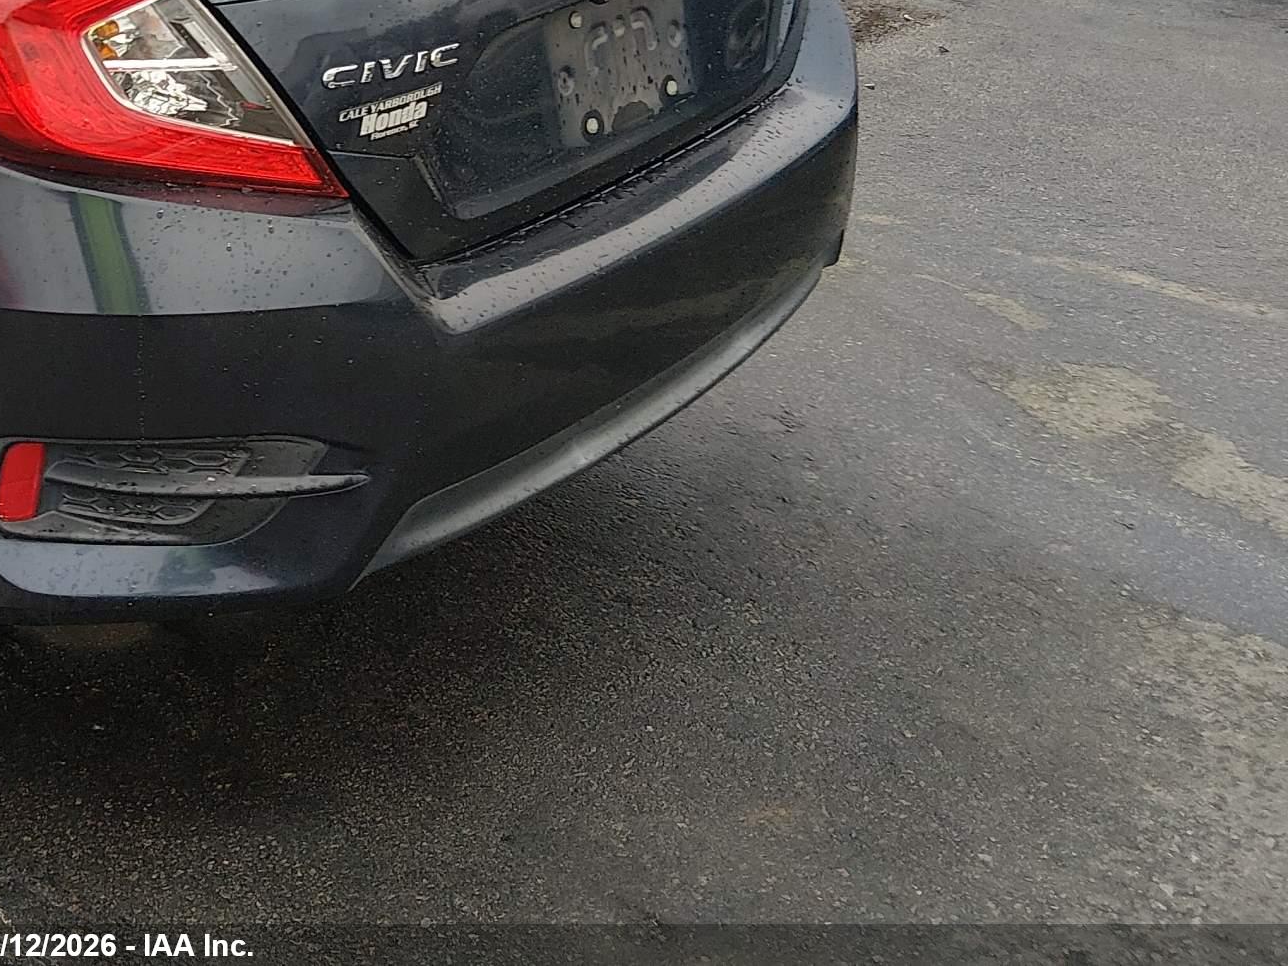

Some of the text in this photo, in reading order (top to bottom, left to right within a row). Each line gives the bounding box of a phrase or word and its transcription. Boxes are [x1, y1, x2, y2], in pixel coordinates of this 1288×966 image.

[322, 42, 460, 89] CIVIC
[338, 106, 369, 122] CALE
[359, 100, 429, 137] Honda
